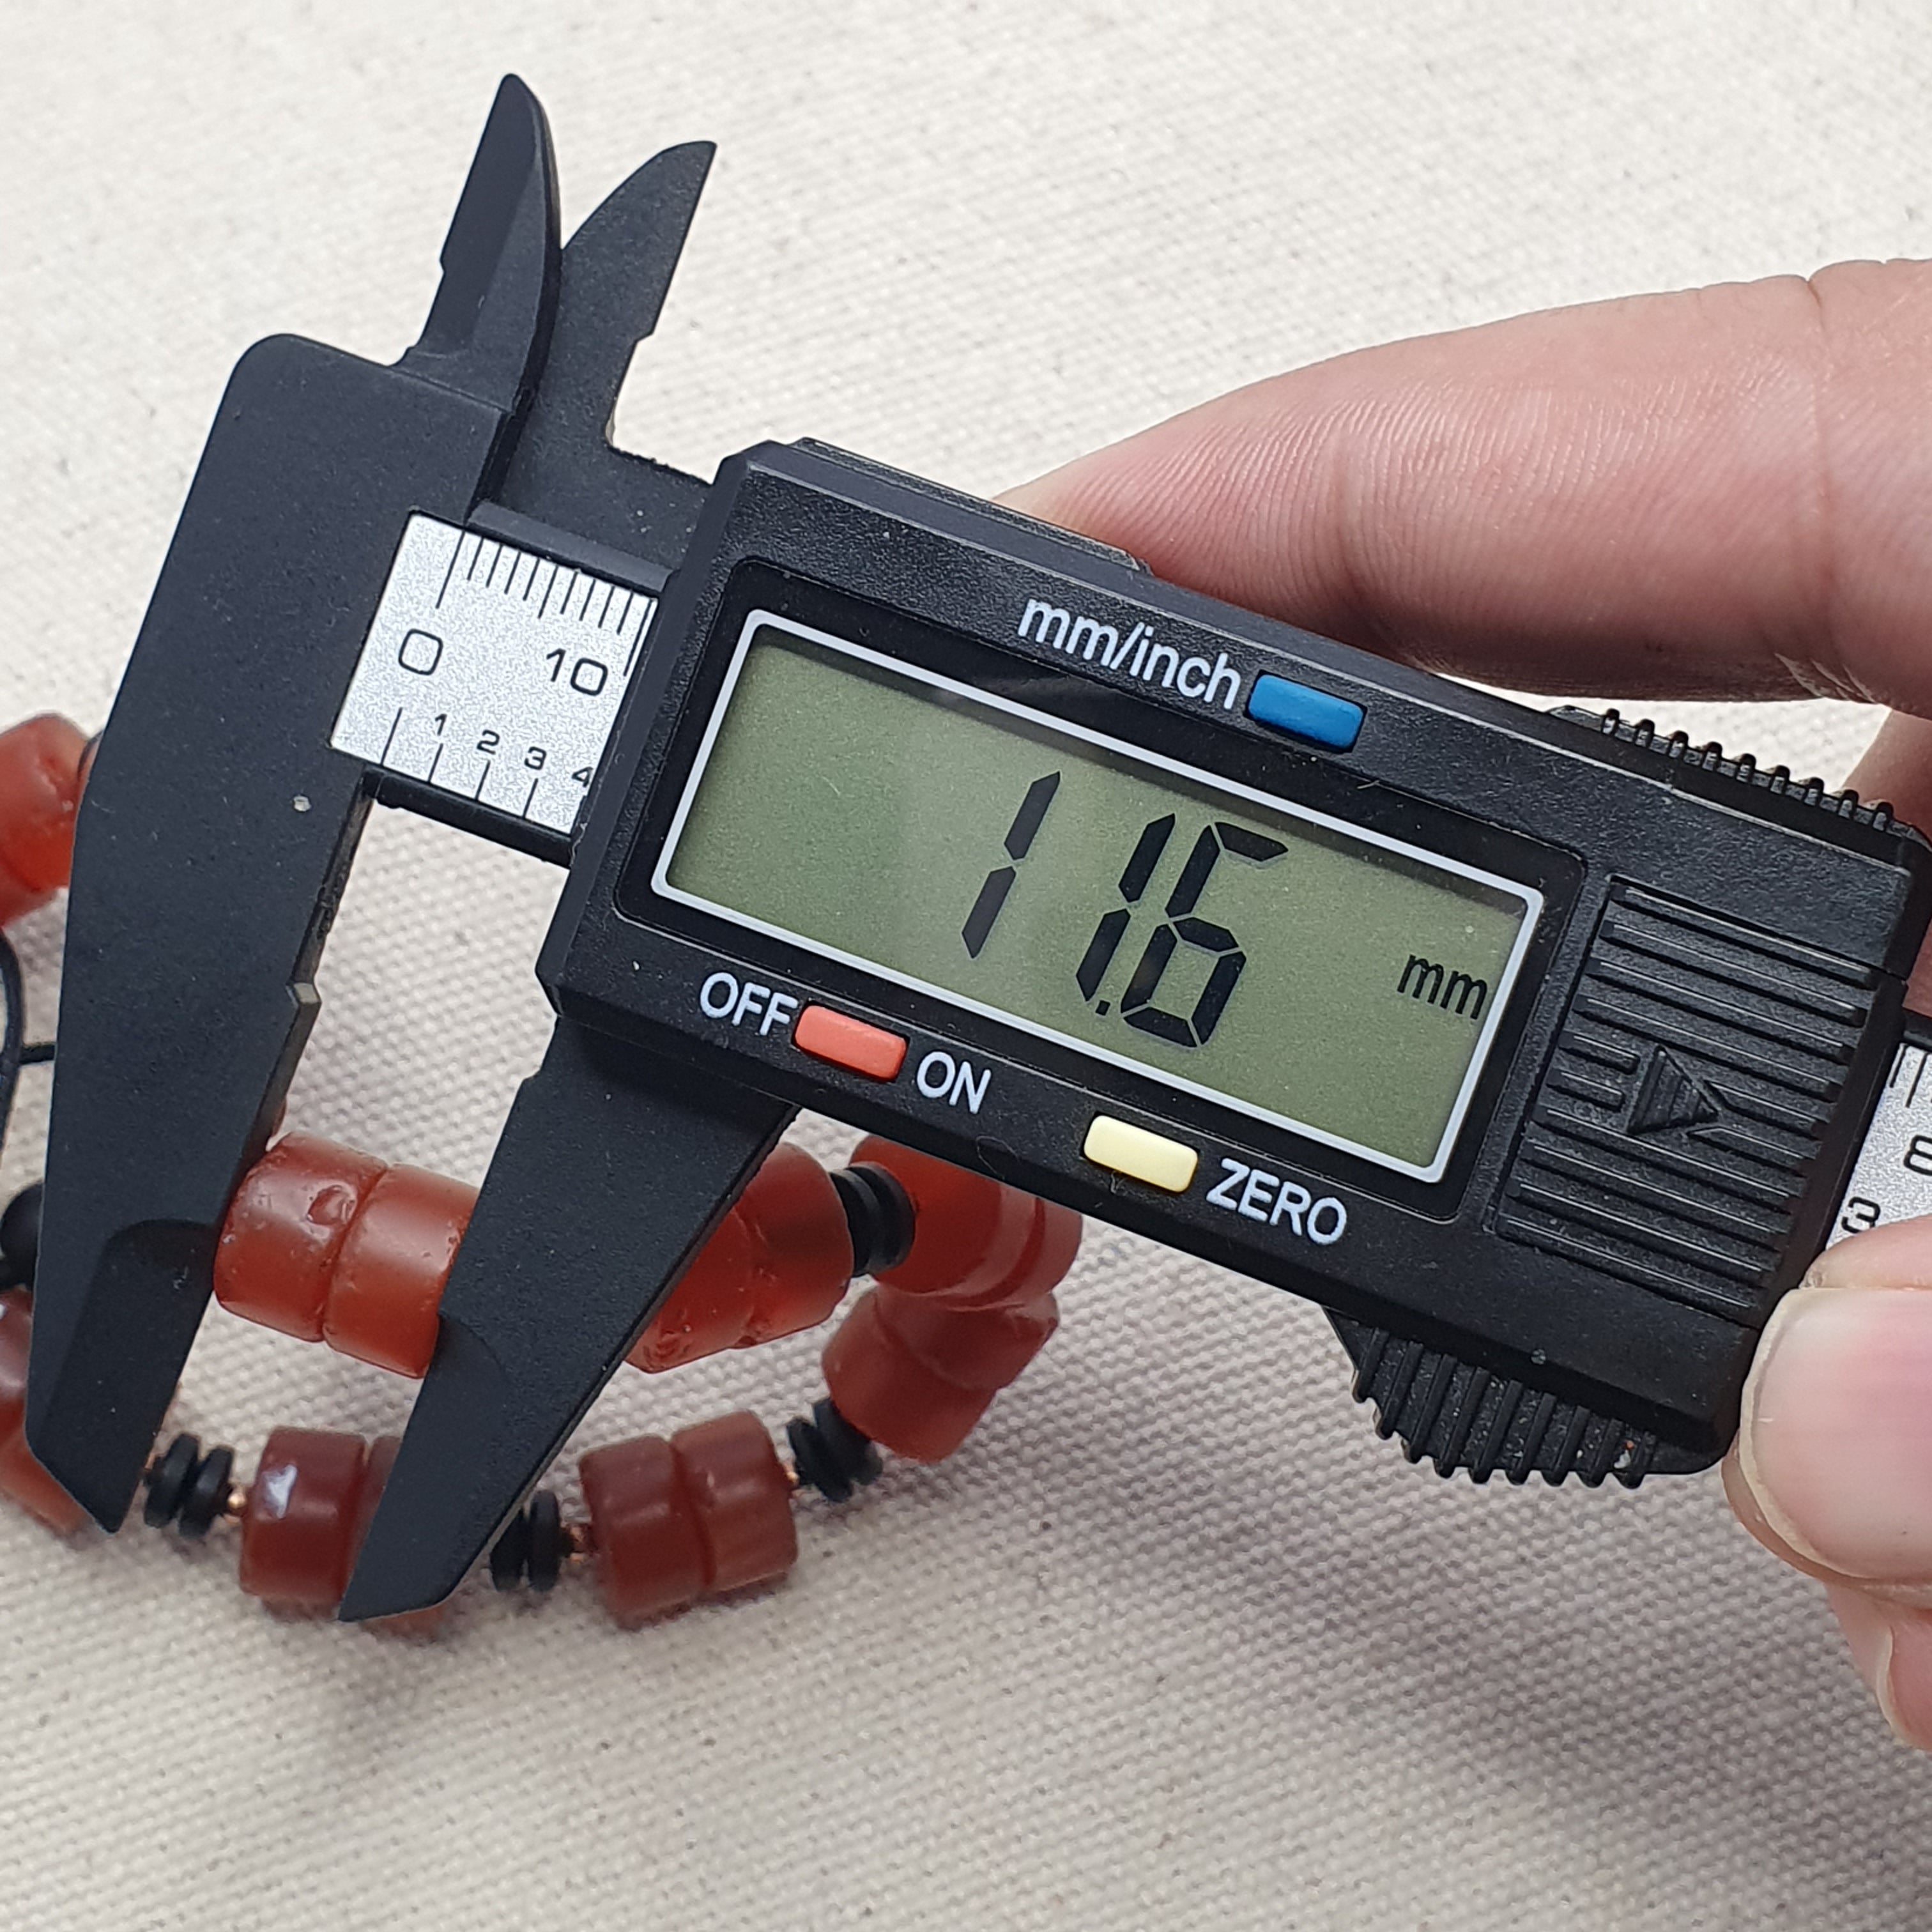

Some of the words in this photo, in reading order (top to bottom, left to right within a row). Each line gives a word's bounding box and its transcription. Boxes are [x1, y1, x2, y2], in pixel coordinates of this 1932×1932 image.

[398, 629, 443, 676] 0
[546, 648, 608, 696] 10
[1017, 598, 1241, 710] mm/inch
[434, 712, 447, 736] 1
[476, 729, 500, 755] 2
[523, 746, 548, 771] 3
[571, 766, 594, 788] 4
[961, 770, 1289, 1048] 11.6
[1397, 954, 1489, 1020] mm
[700, 972, 799, 1036] OFF
[916, 1050, 992, 1114] ON
[1206, 1158, 1347, 1245] ZERO
[1841, 1196, 1882, 1234] 3
